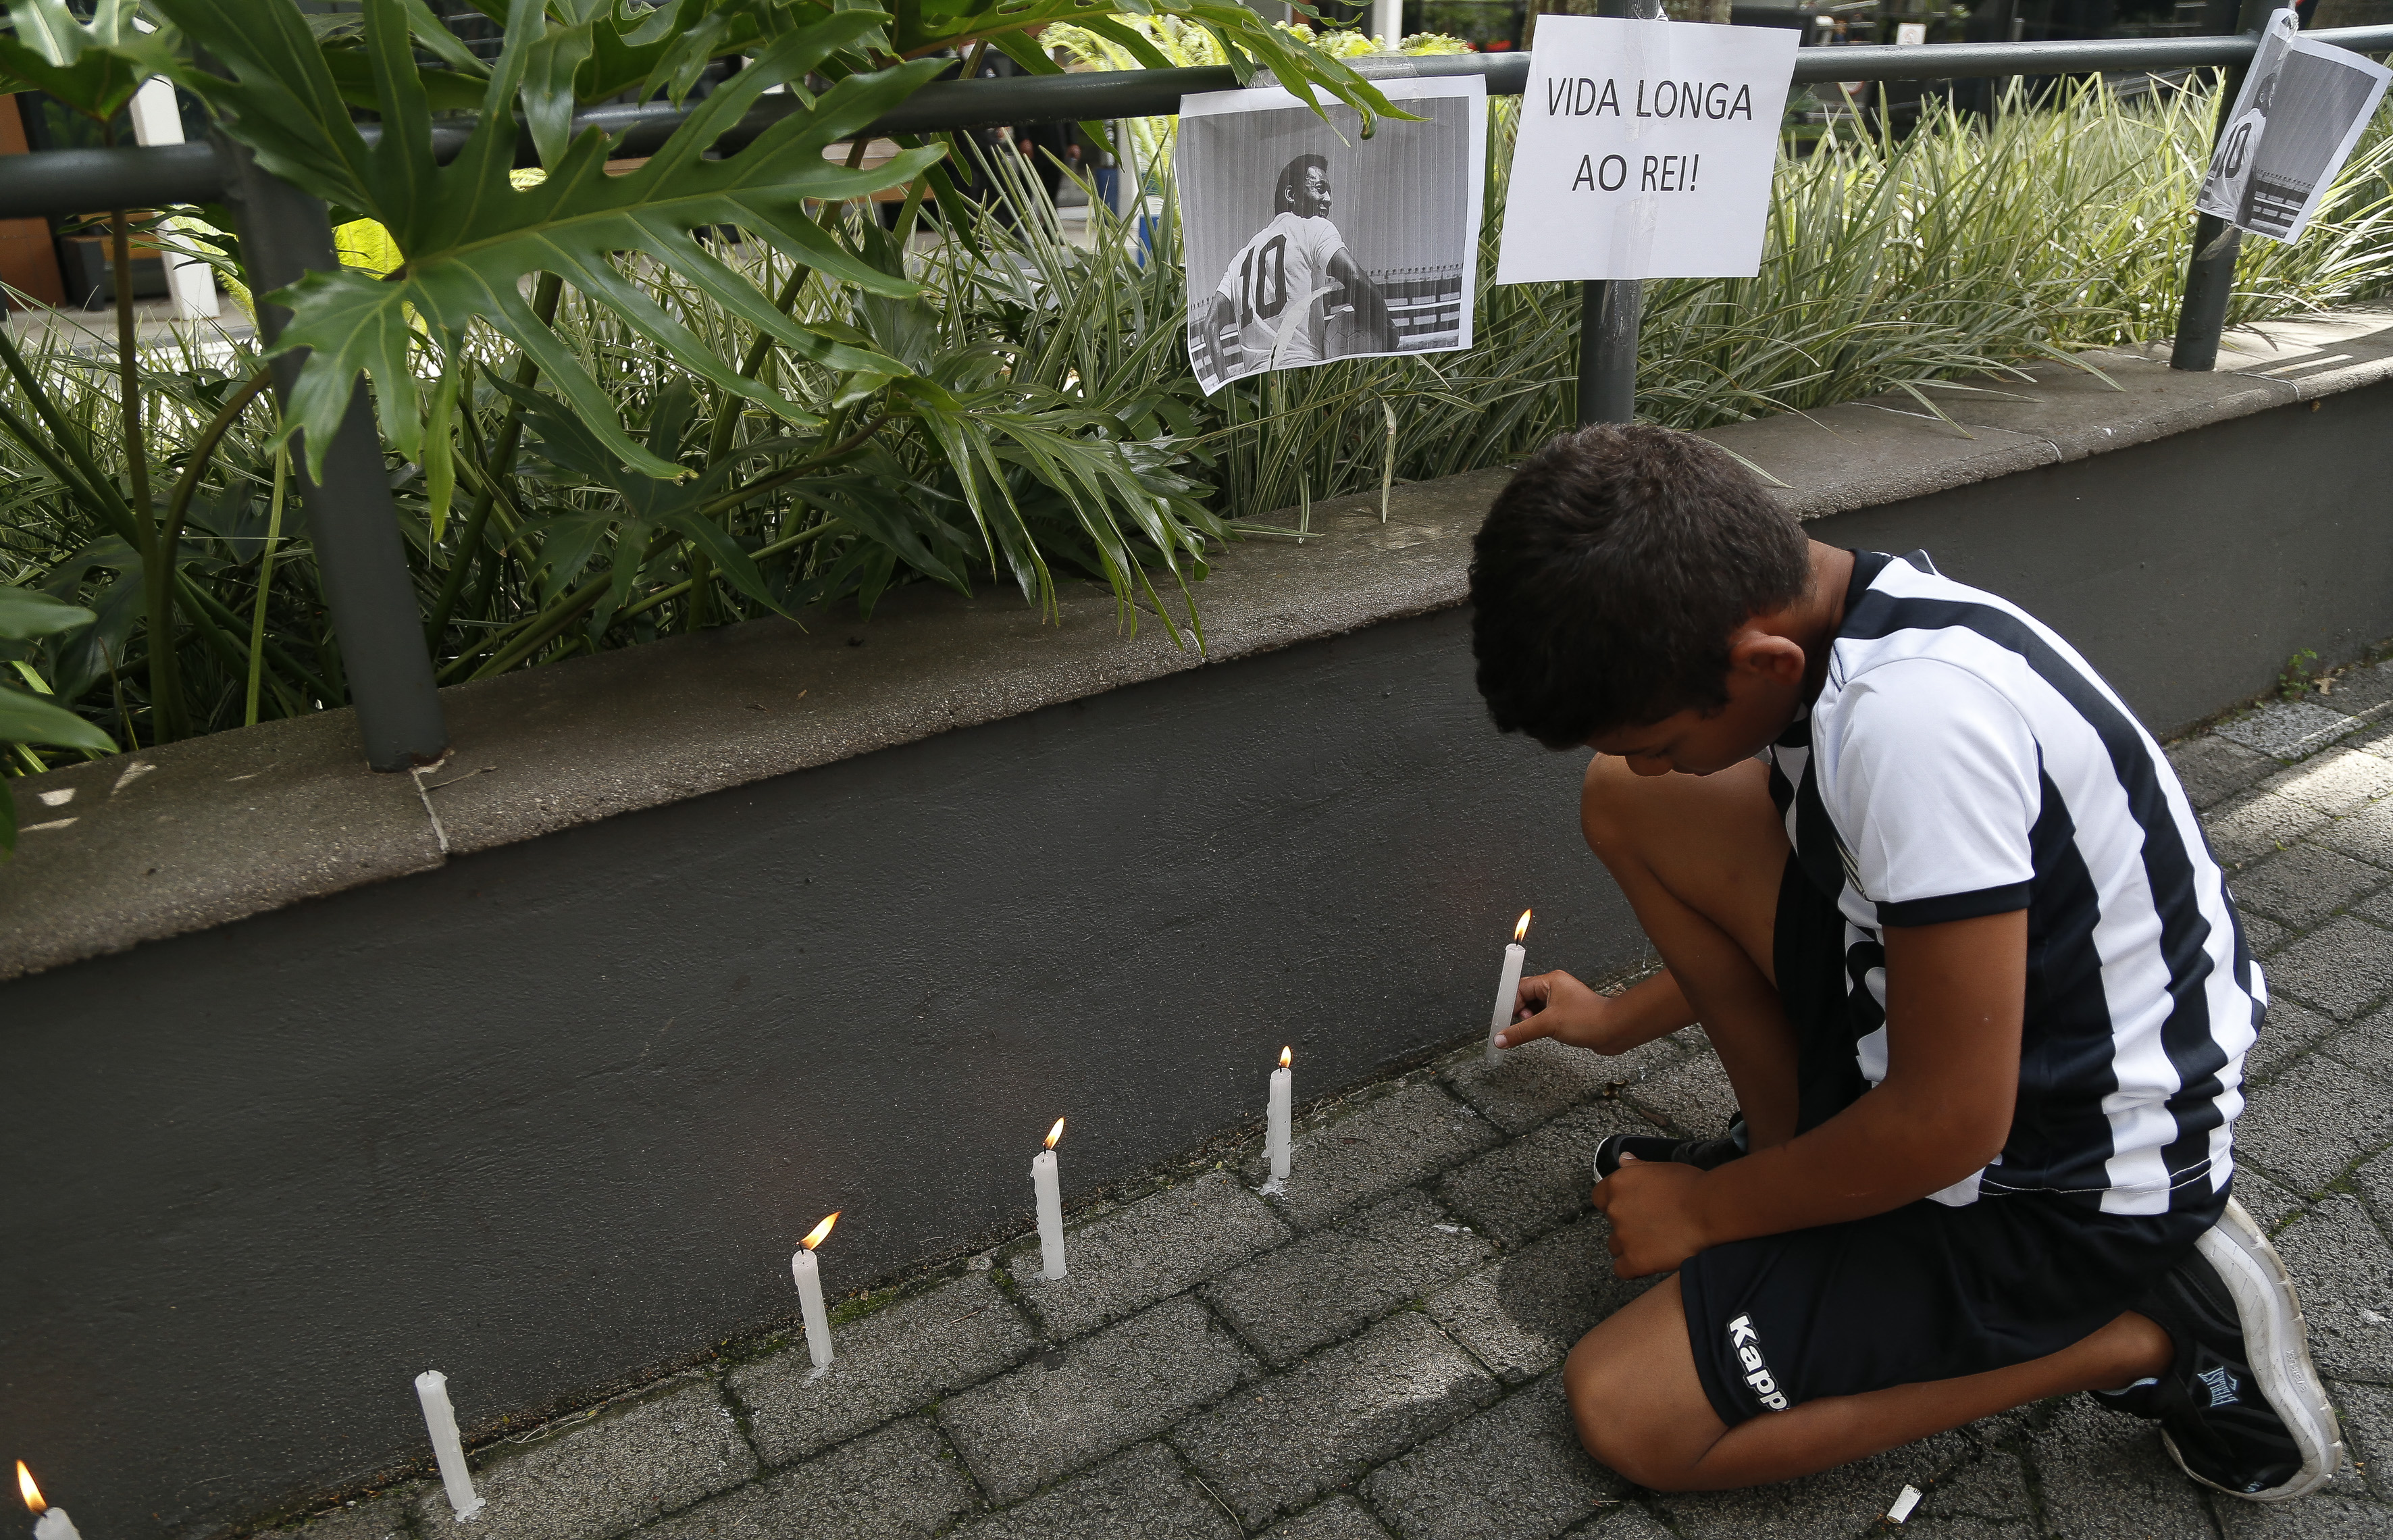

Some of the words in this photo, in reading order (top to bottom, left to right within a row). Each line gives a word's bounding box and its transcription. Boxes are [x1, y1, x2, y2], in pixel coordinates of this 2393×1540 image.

[1548, 77, 1620, 117] VIDA
[1636, 79, 1752, 121] LONGA
[1572, 154, 1627, 192] AO
[1641, 153, 1699, 192] REI!
[2215, 122, 2253, 178] 10
[1239, 233, 1288, 329] 10
[1729, 1314, 1791, 1412] Kapp
[2196, 1366, 2239, 1408] EVERLAST
